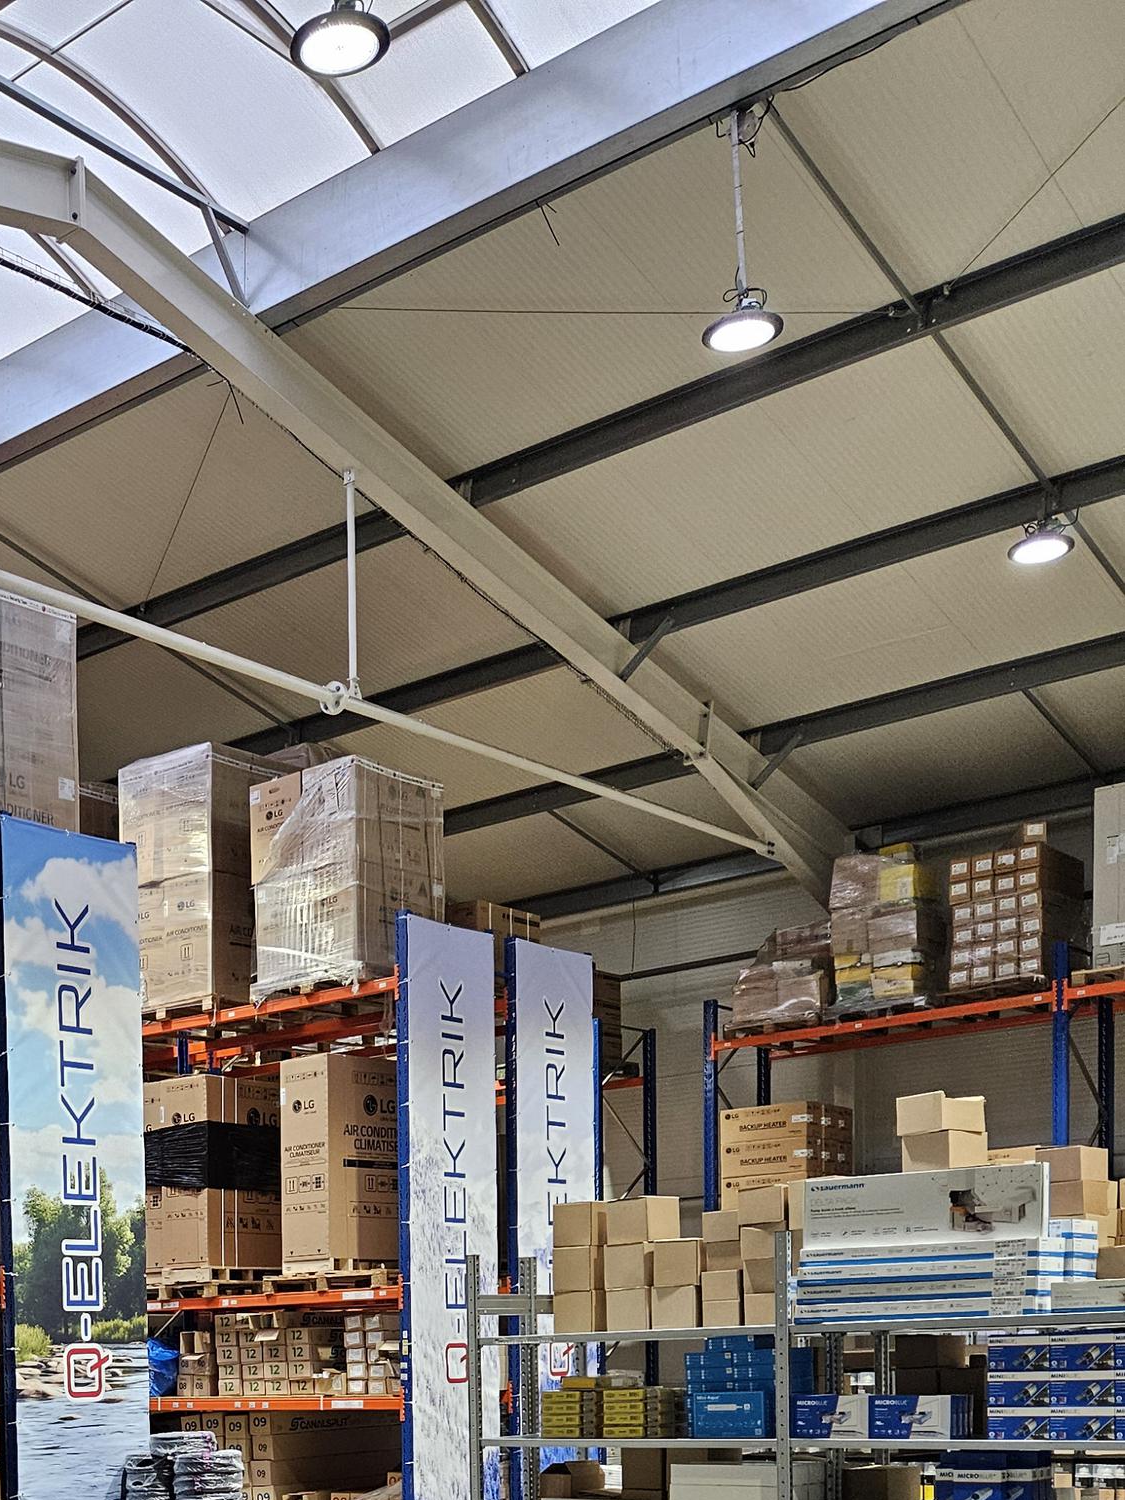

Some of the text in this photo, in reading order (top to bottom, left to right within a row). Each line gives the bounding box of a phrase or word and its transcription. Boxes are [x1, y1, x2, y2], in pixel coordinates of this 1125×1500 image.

[9, 774, 25, 789] LG
[274, 810, 283, 818] LG
[185, 900, 195, 909] LG
[303, 1100, 315, 1110] LG
[380, 1100, 396, 1114] LG
[183, 1112, 195, 1122] LG
[343, 1124, 359, 1136] AIR
[739, 1121, 787, 1131] BACKUP HEATER
[52, 896, 113, 1402] Q-ELEKTRIK
[293, 1142, 325, 1151] CONDITIONER
[289, 1149, 320, 1158] CLIMATISEUR
[740, 1155, 787, 1165] BACKUP HEATER
[820, 1183, 864, 1191] sauermann
[220, 1318, 231, 1327] 12
[220, 1332, 254, 1343] 12 12
[291, 1330, 302, 1340] 12
[221, 1347, 303, 1360] 12 12 12 12
[223, 1365, 280, 1376] 12 12 12
[179, 1382, 187, 1390] 08
[224, 1380, 307, 1392] 12 12 12 12
[185, 1417, 267, 1432] 09 09 09 09
[259, 1444, 267, 1452] 09
[257, 1469, 266, 1477] 09
